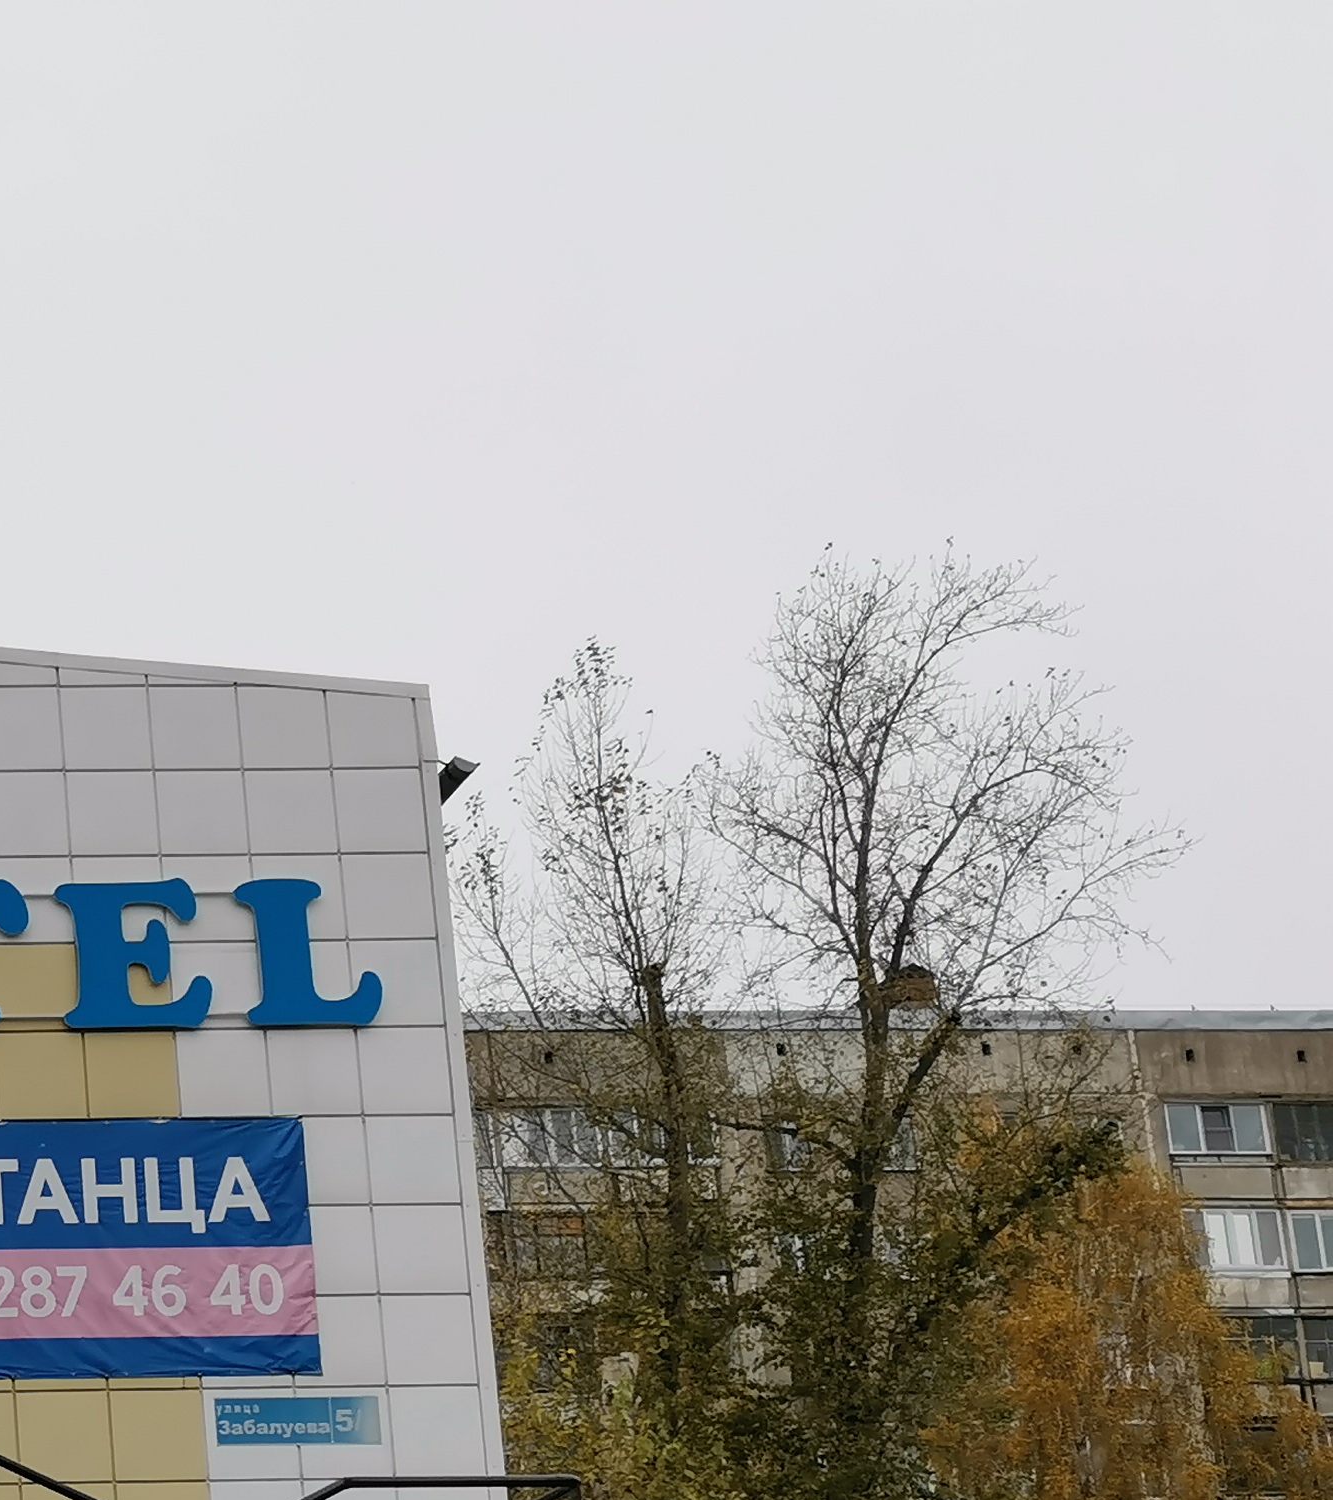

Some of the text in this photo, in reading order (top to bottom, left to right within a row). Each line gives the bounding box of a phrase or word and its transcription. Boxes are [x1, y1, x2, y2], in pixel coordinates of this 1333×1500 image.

[111, 1264, 188, 1318] 46
[209, 1262, 285, 1317] 40
[216, 1403, 260, 1417] улица
[218, 1419, 331, 1438] Забалуева
